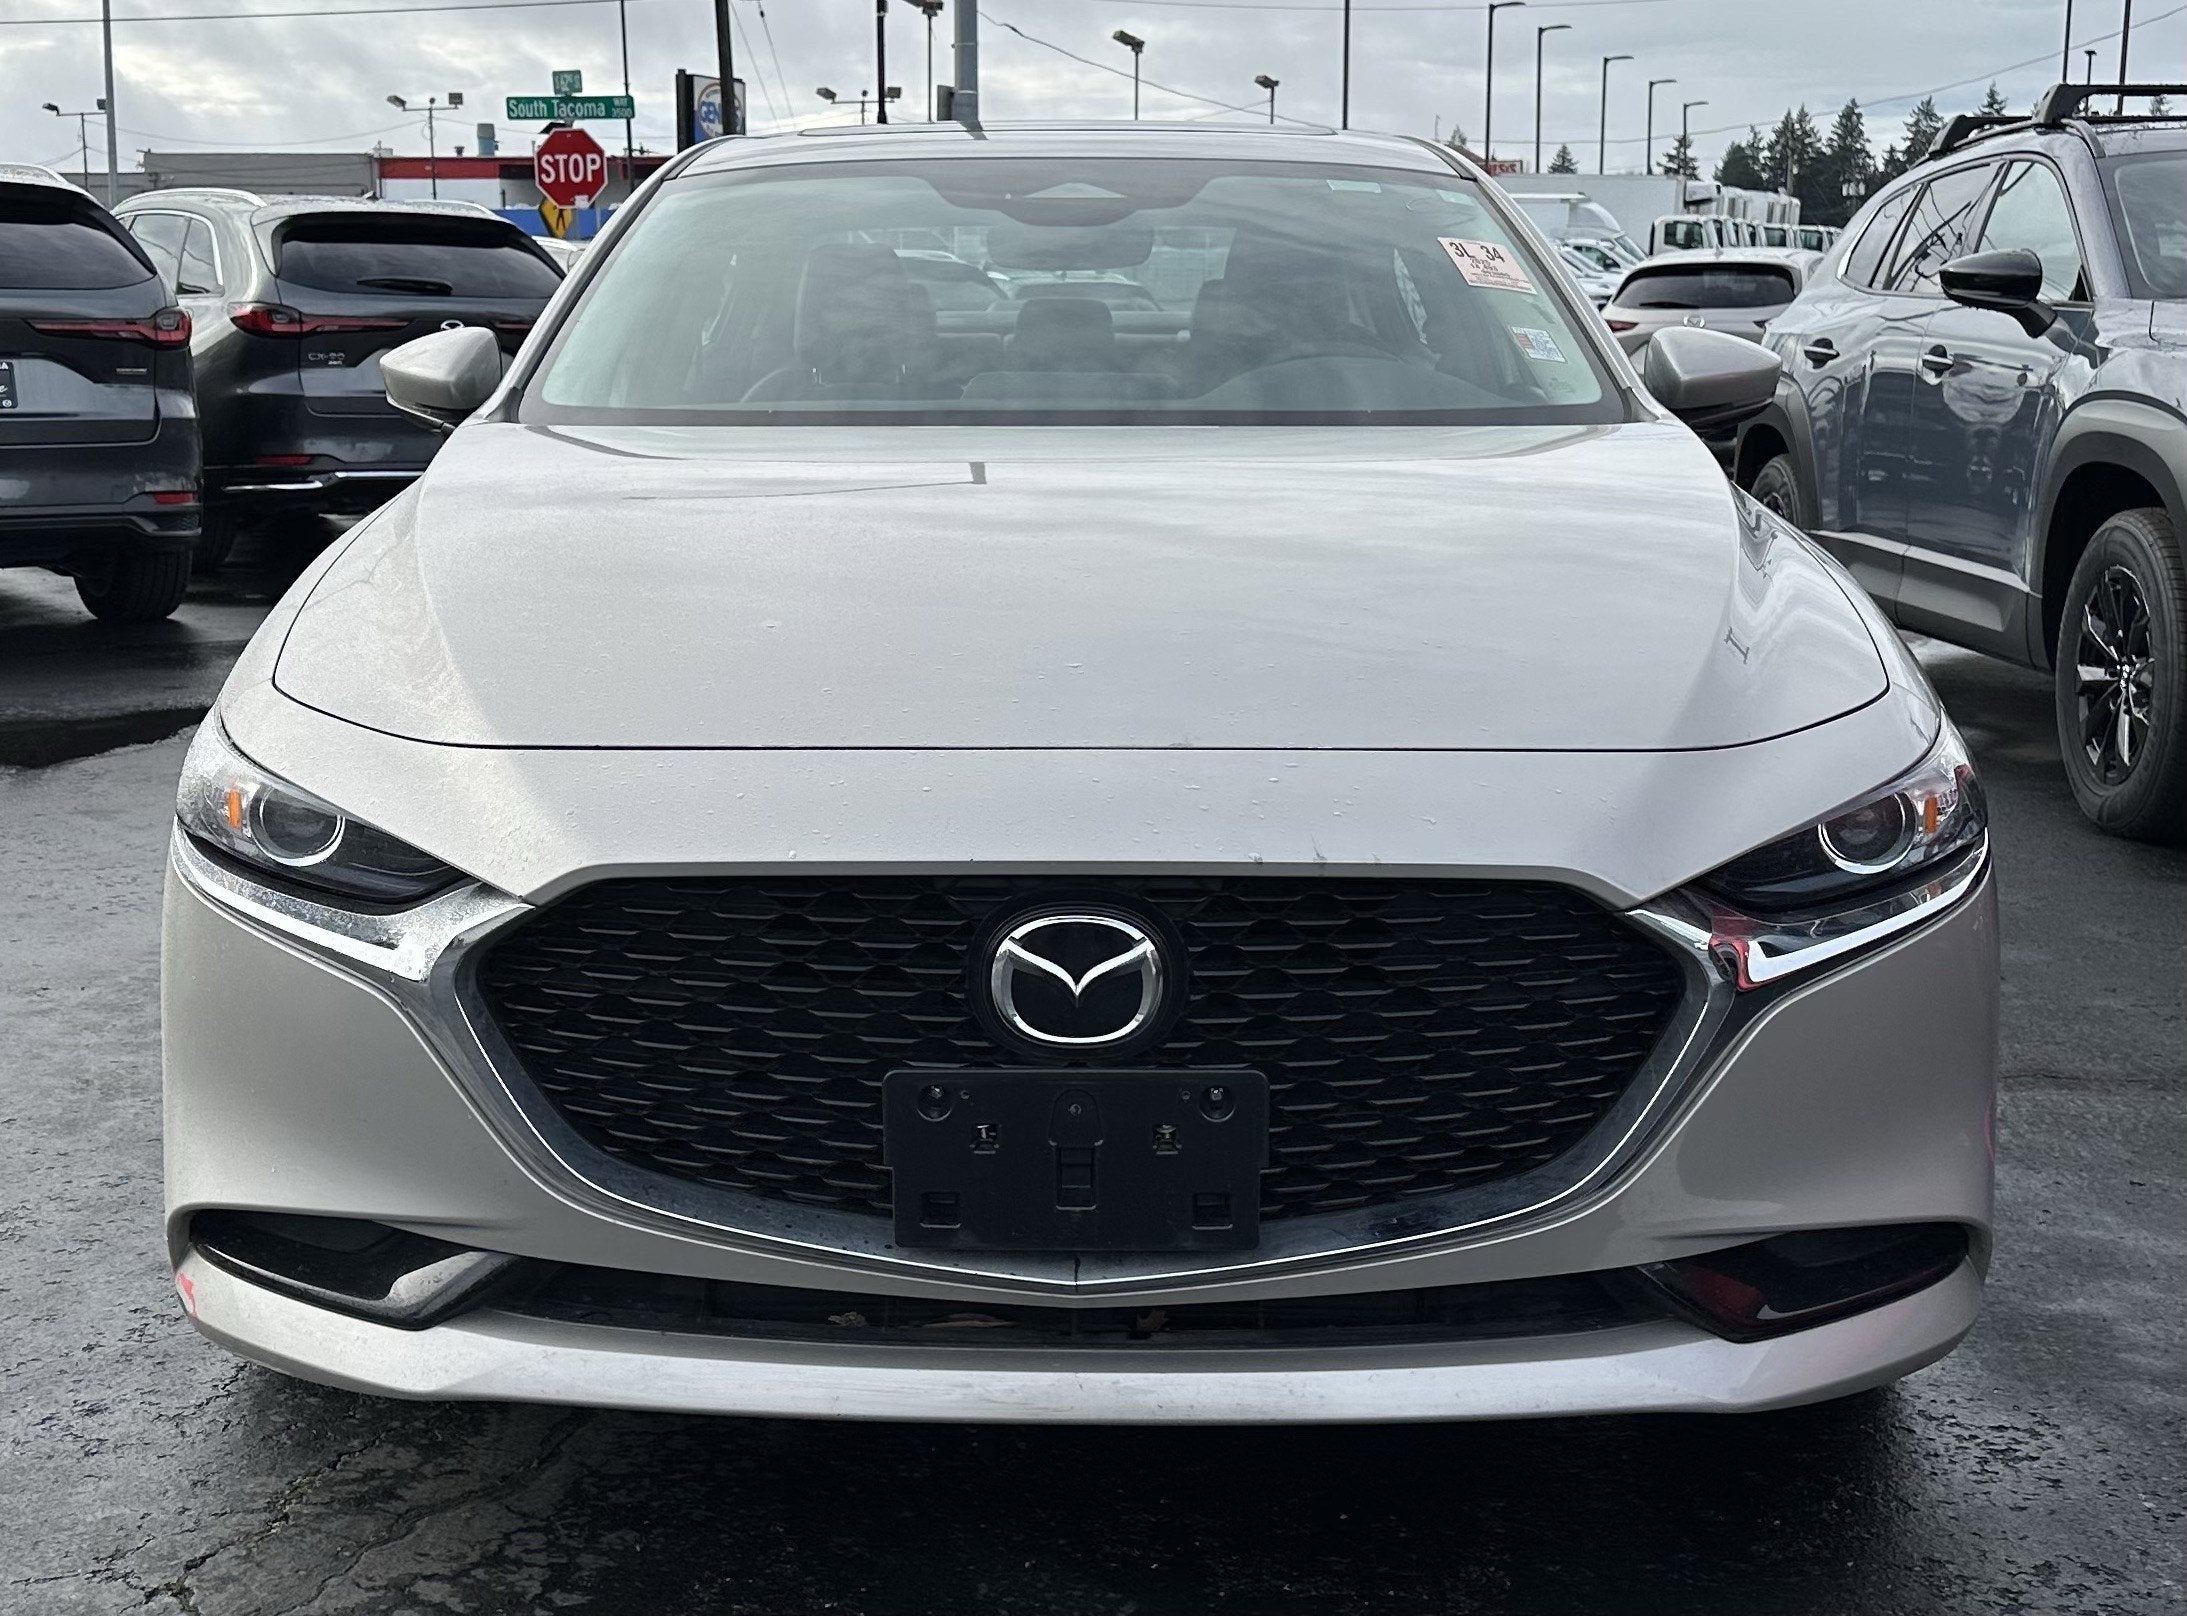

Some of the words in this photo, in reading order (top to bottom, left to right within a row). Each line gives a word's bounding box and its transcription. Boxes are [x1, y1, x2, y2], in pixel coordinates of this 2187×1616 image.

[508, 99, 548, 117] South
[551, 99, 606, 117] Tacoma
[540, 153, 602, 184] STOP
[1449, 242, 1477, 258] 3L
[1480, 245, 1506, 263] 34
